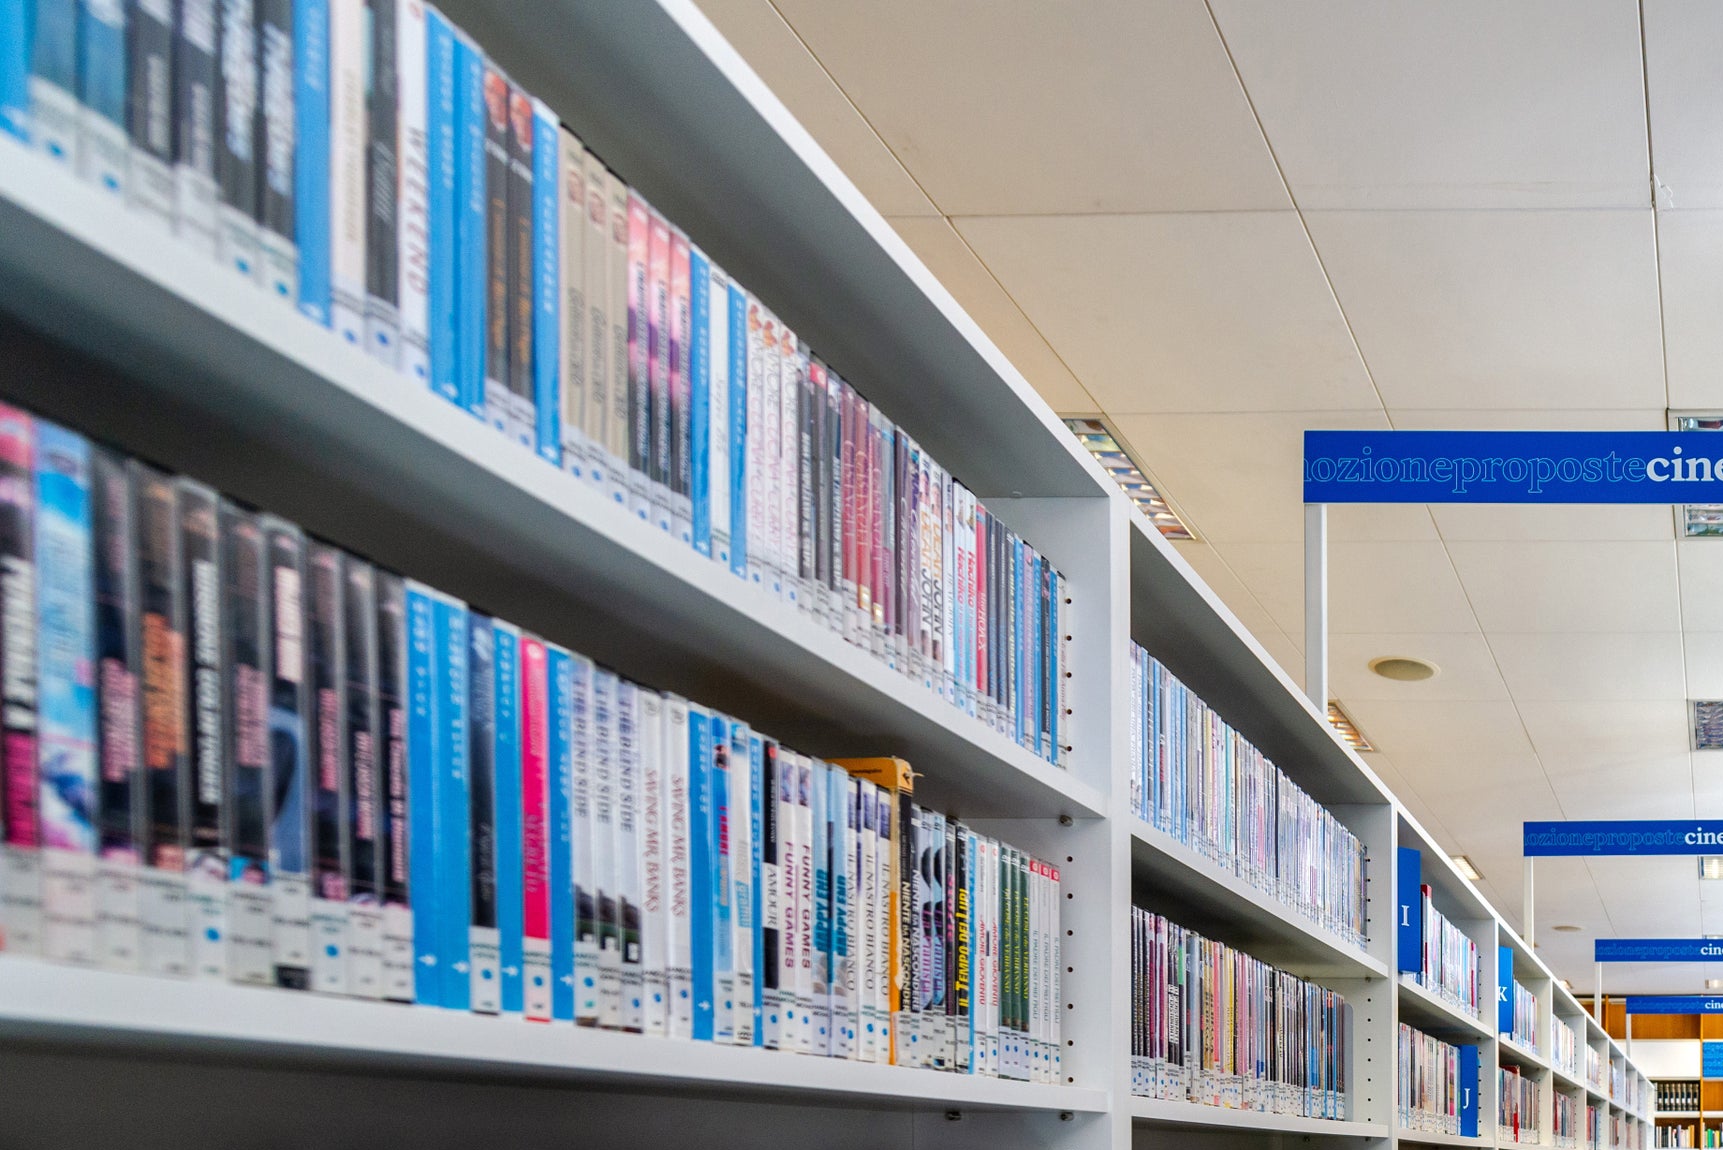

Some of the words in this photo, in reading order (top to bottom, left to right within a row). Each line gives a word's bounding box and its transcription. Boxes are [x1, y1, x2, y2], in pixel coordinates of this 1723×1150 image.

[766, 867, 778, 927] AMOUR
[785, 841, 793, 901] FUNNY
[802, 845, 810, 901] FUNNY
[785, 907, 793, 968] GAMES
[802, 909, 810, 969] GAMES
[1401, 905, 1410, 926] I
[1499, 986, 1508, 1002] K
[1463, 1088, 1470, 1109] J
